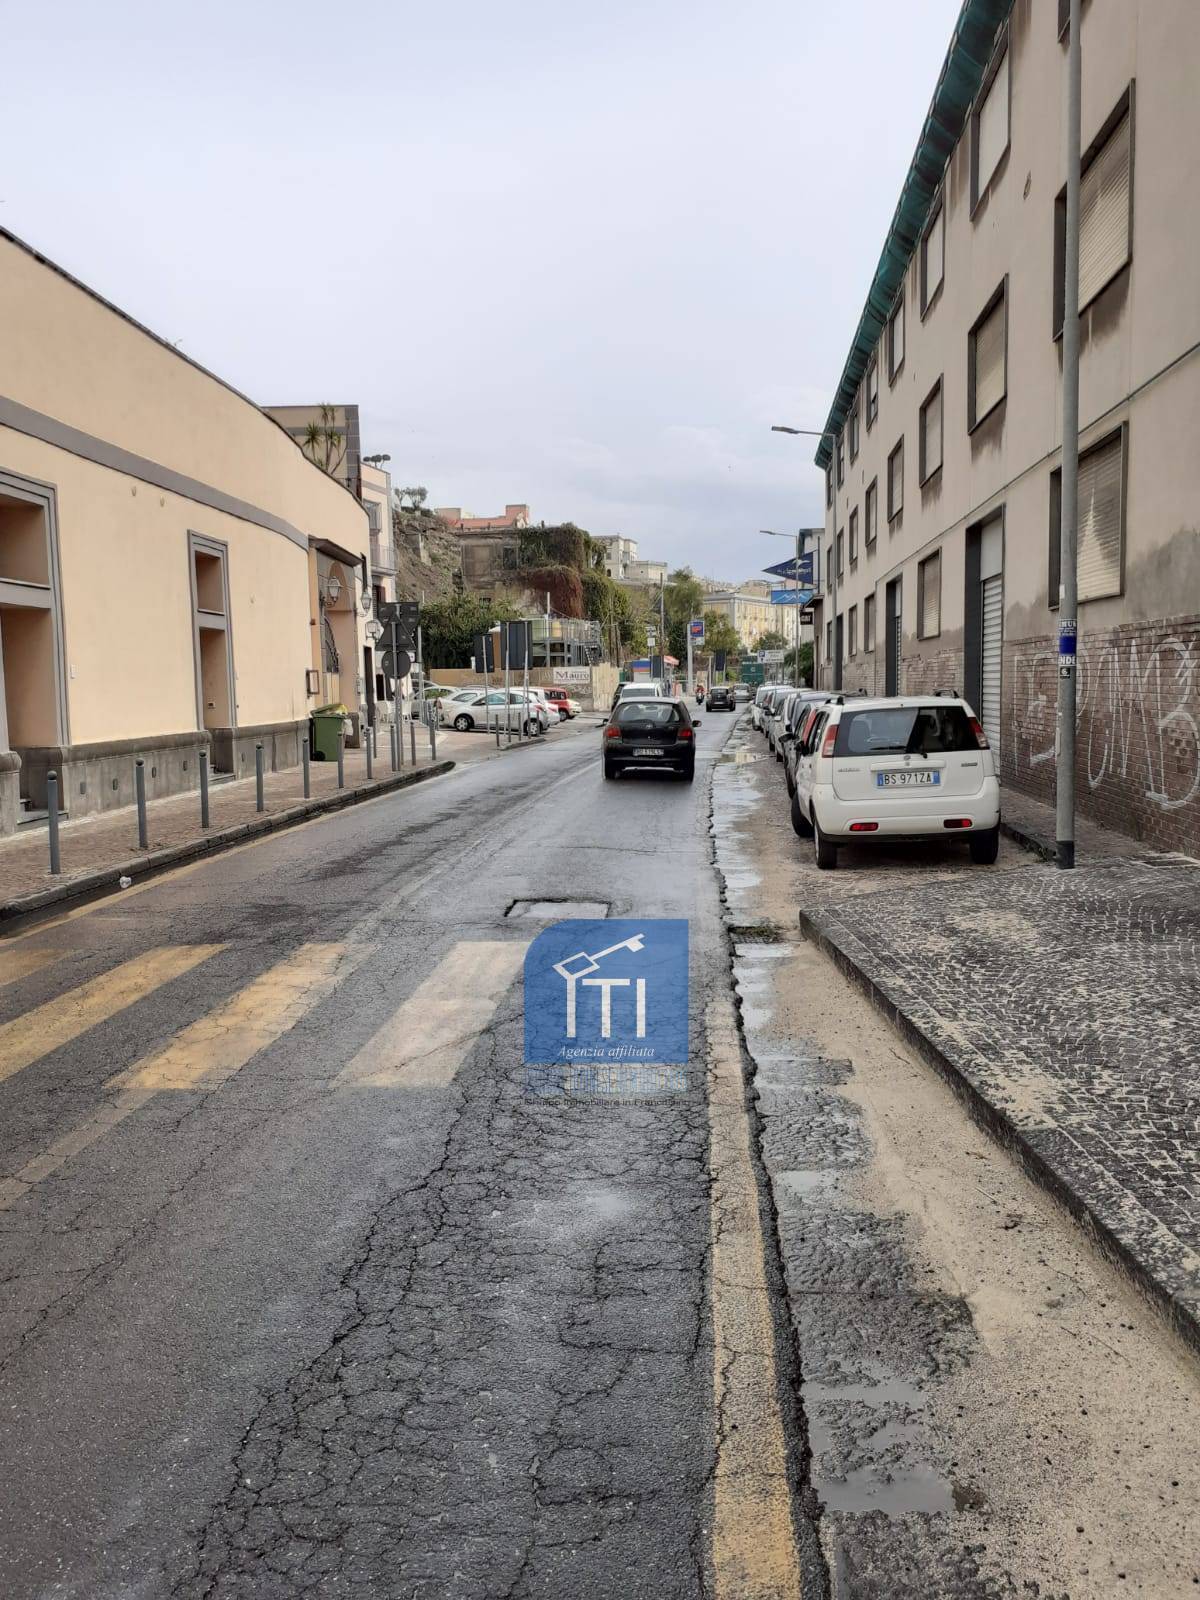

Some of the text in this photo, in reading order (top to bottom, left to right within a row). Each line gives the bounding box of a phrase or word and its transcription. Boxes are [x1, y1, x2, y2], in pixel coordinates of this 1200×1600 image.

[555, 671, 590, 679] Mauro
[884, 772, 932, 785] BS 971ZA
